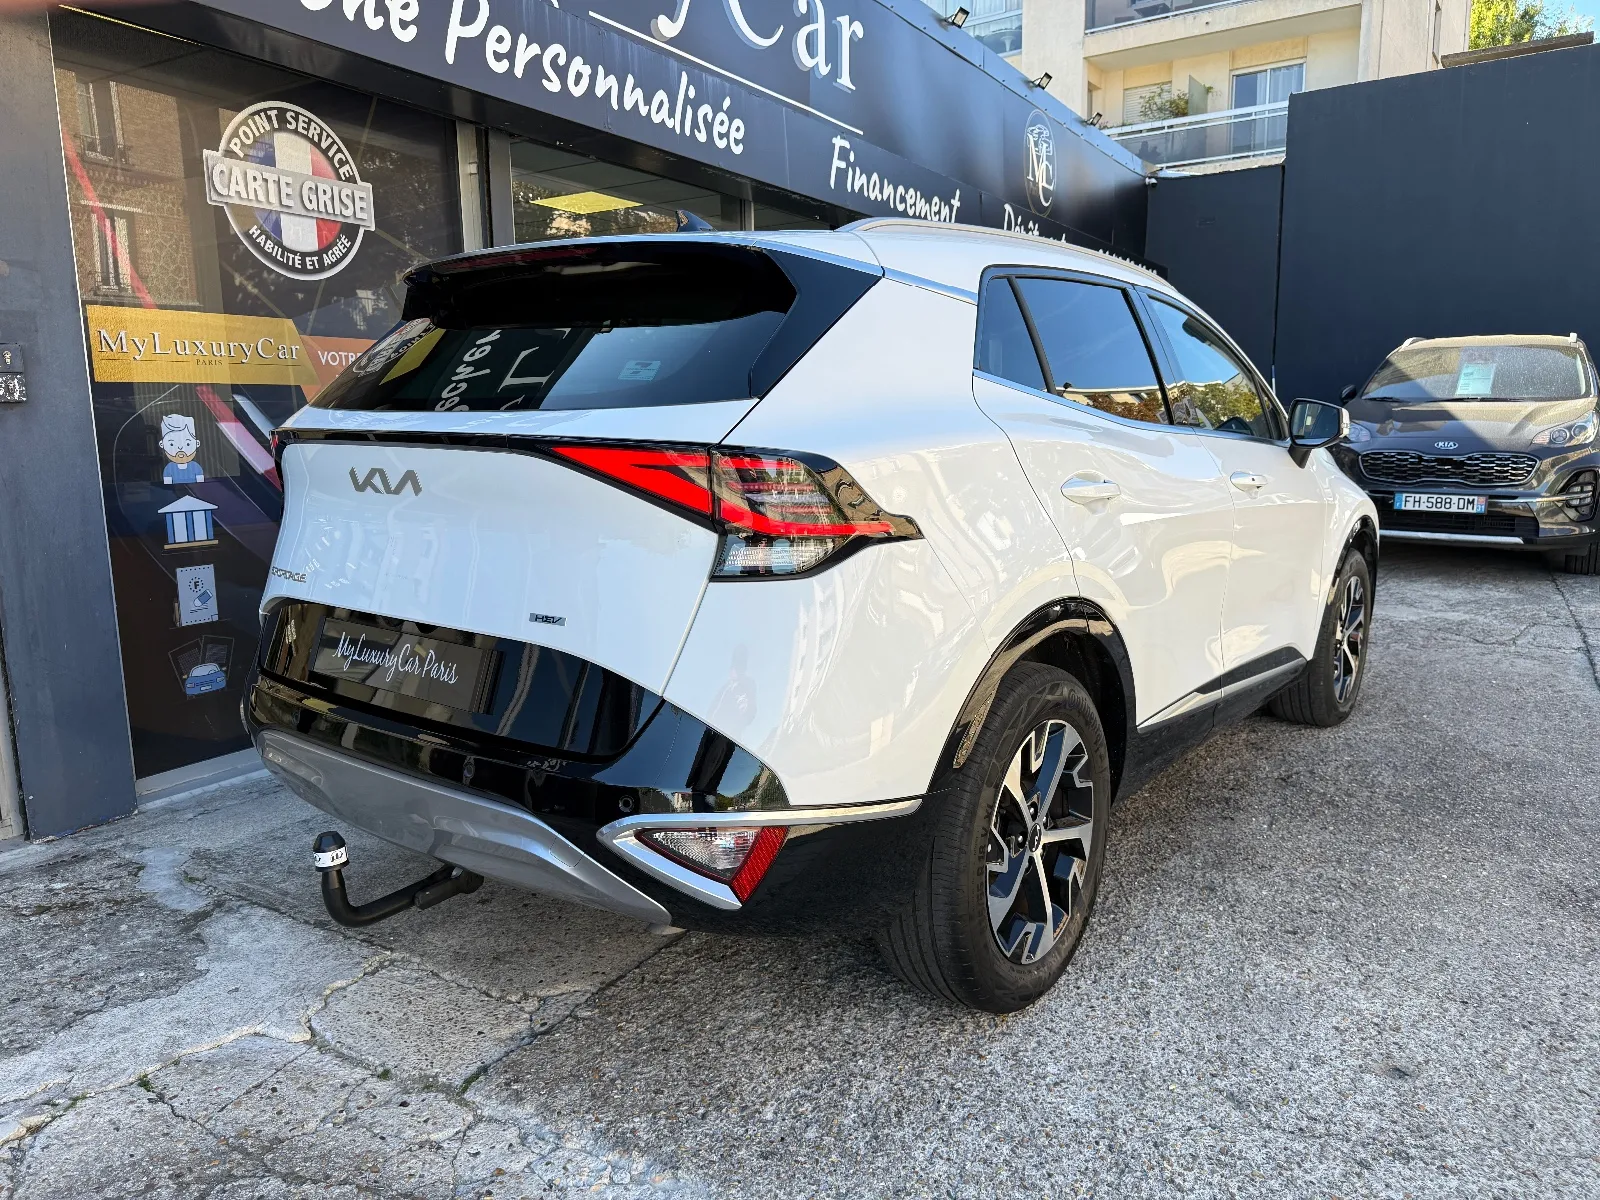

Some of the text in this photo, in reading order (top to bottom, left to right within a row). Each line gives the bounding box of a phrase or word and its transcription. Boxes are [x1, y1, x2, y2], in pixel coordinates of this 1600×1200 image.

[445, 0, 746, 155] Personnalisée
[229, 109, 353, 180] POINT SERVICE
[212, 163, 368, 220] CARTE GRISE
[829, 134, 961, 223] Financement
[249, 225, 302, 269] HABILITÉ
[305, 256, 320, 270] ET
[97, 328, 300, 364] MyLuxuryCar
[196, 358, 223, 366] PARIS
[317, 350, 363, 366] VOTR
[1404, 496, 1476, 511] FH-588-DM
[422, 649, 459, 684] Paris
